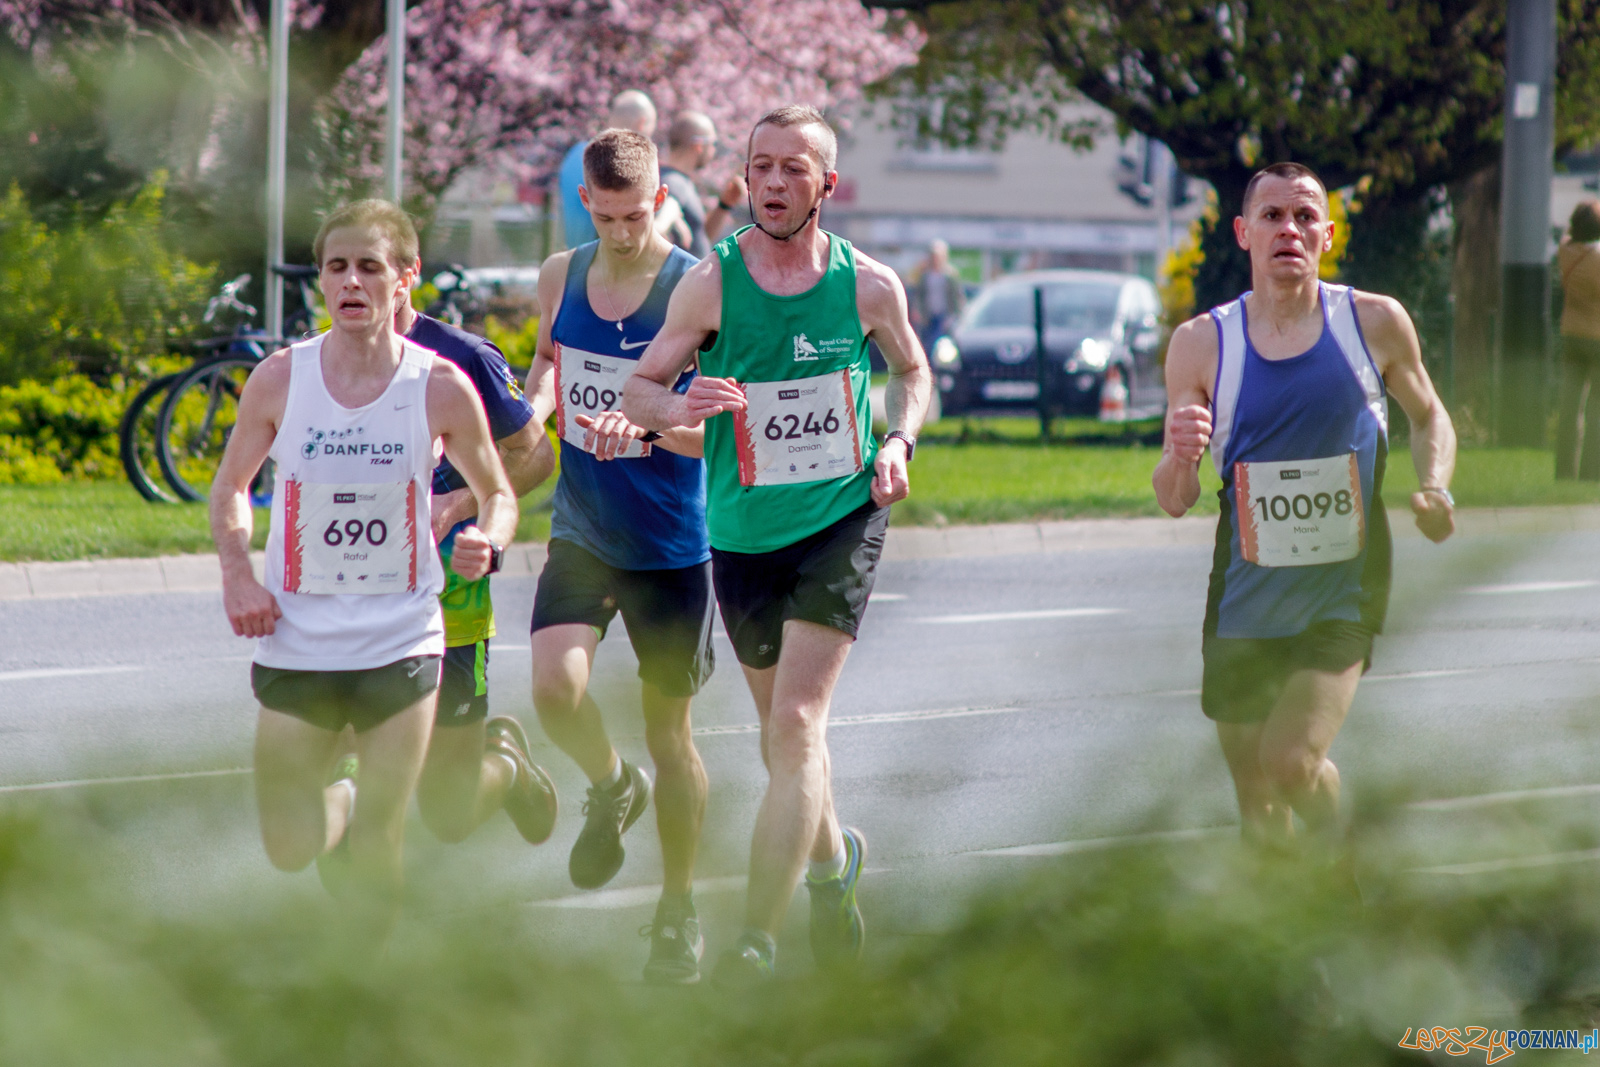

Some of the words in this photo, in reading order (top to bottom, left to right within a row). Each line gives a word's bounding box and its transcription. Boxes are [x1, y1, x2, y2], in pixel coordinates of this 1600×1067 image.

[569, 382, 624, 412] 609
[764, 407, 840, 441] 6246
[324, 443, 404, 456] DANFLOR
[788, 443, 822, 454] Damian
[1255, 489, 1353, 522] 10098
[323, 519, 388, 547] 690
[1293, 525, 1321, 534] Marek
[343, 552, 368, 562] Rafał
